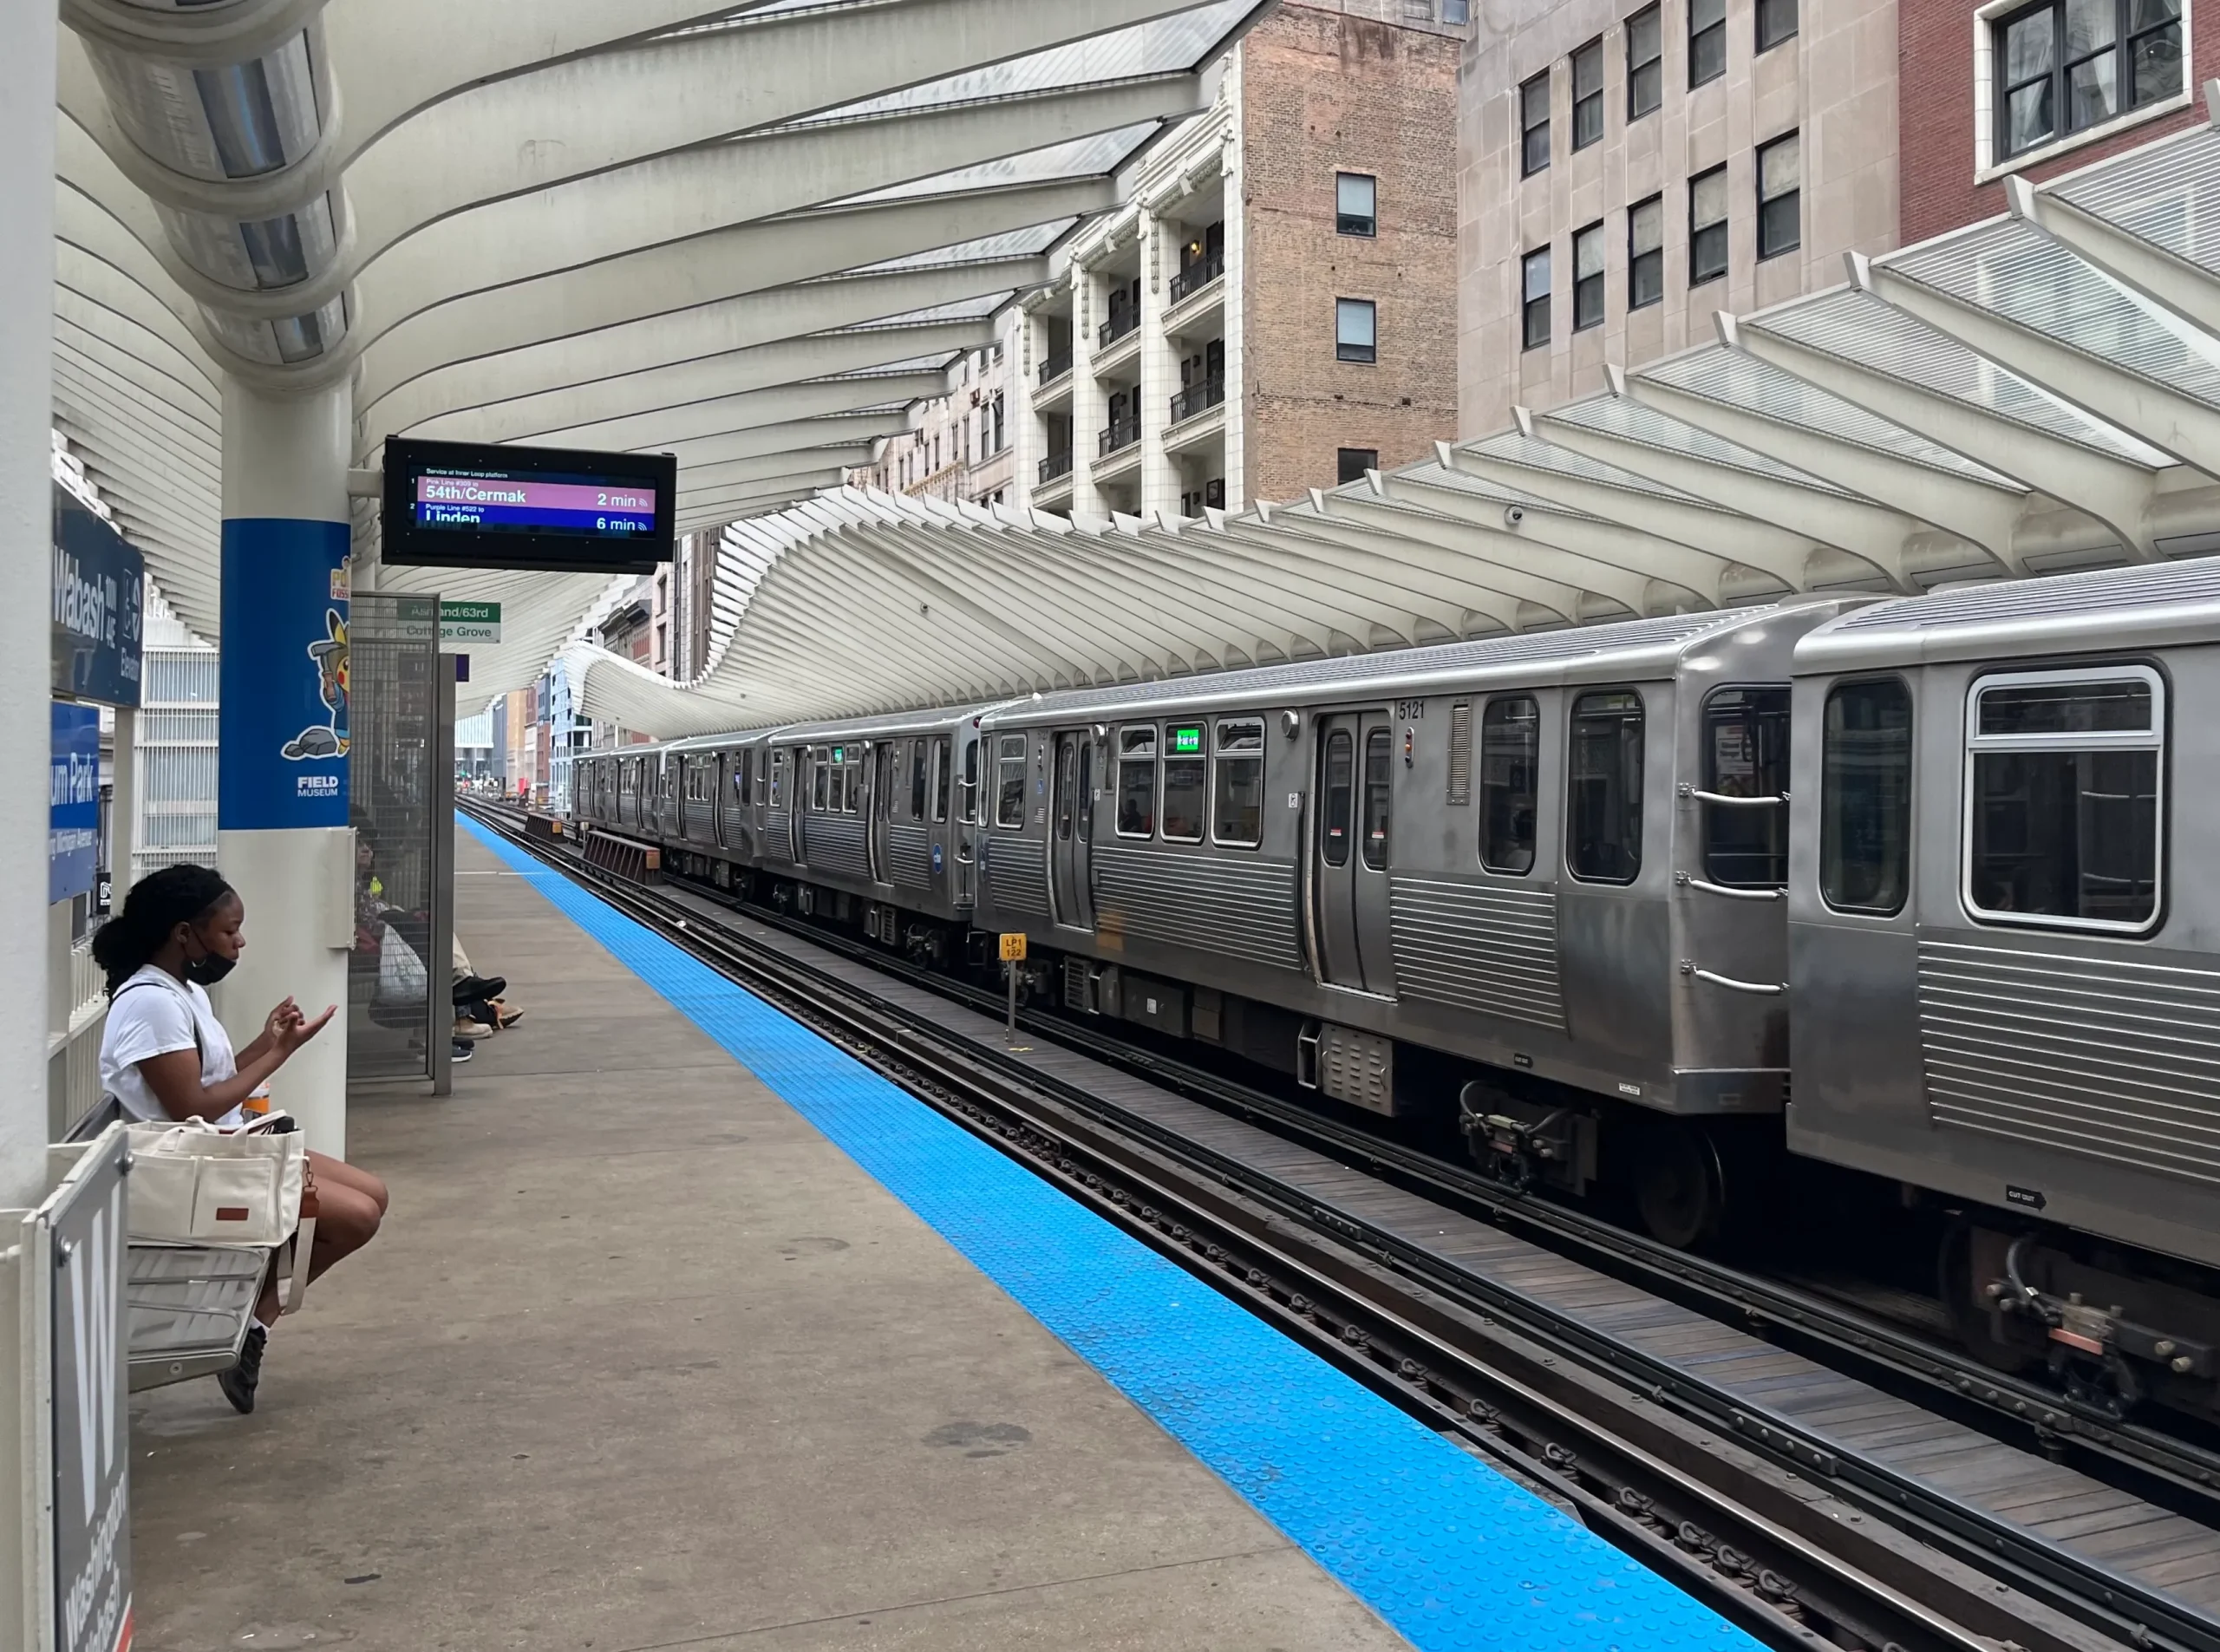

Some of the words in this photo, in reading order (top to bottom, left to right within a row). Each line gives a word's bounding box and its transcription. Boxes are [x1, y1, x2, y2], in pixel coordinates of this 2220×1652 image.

[426, 485, 526, 503] 54th/Cermak
[597, 493, 607, 506] 2
[610, 494, 637, 507] min
[426, 503, 446, 512] Purple
[597, 517, 606, 530] 6
[610, 518, 636, 531] min
[406, 625, 453, 638] Cottge
[456, 626, 492, 637] Grove
[1399, 701, 1425, 720] 5121
[69, 752, 94, 805] Park
[297, 775, 339, 788] FIELD
[297, 787, 338, 797] MUSEUM
[1006, 938, 1022, 947] LP1
[70, 1179, 121, 1529] W
